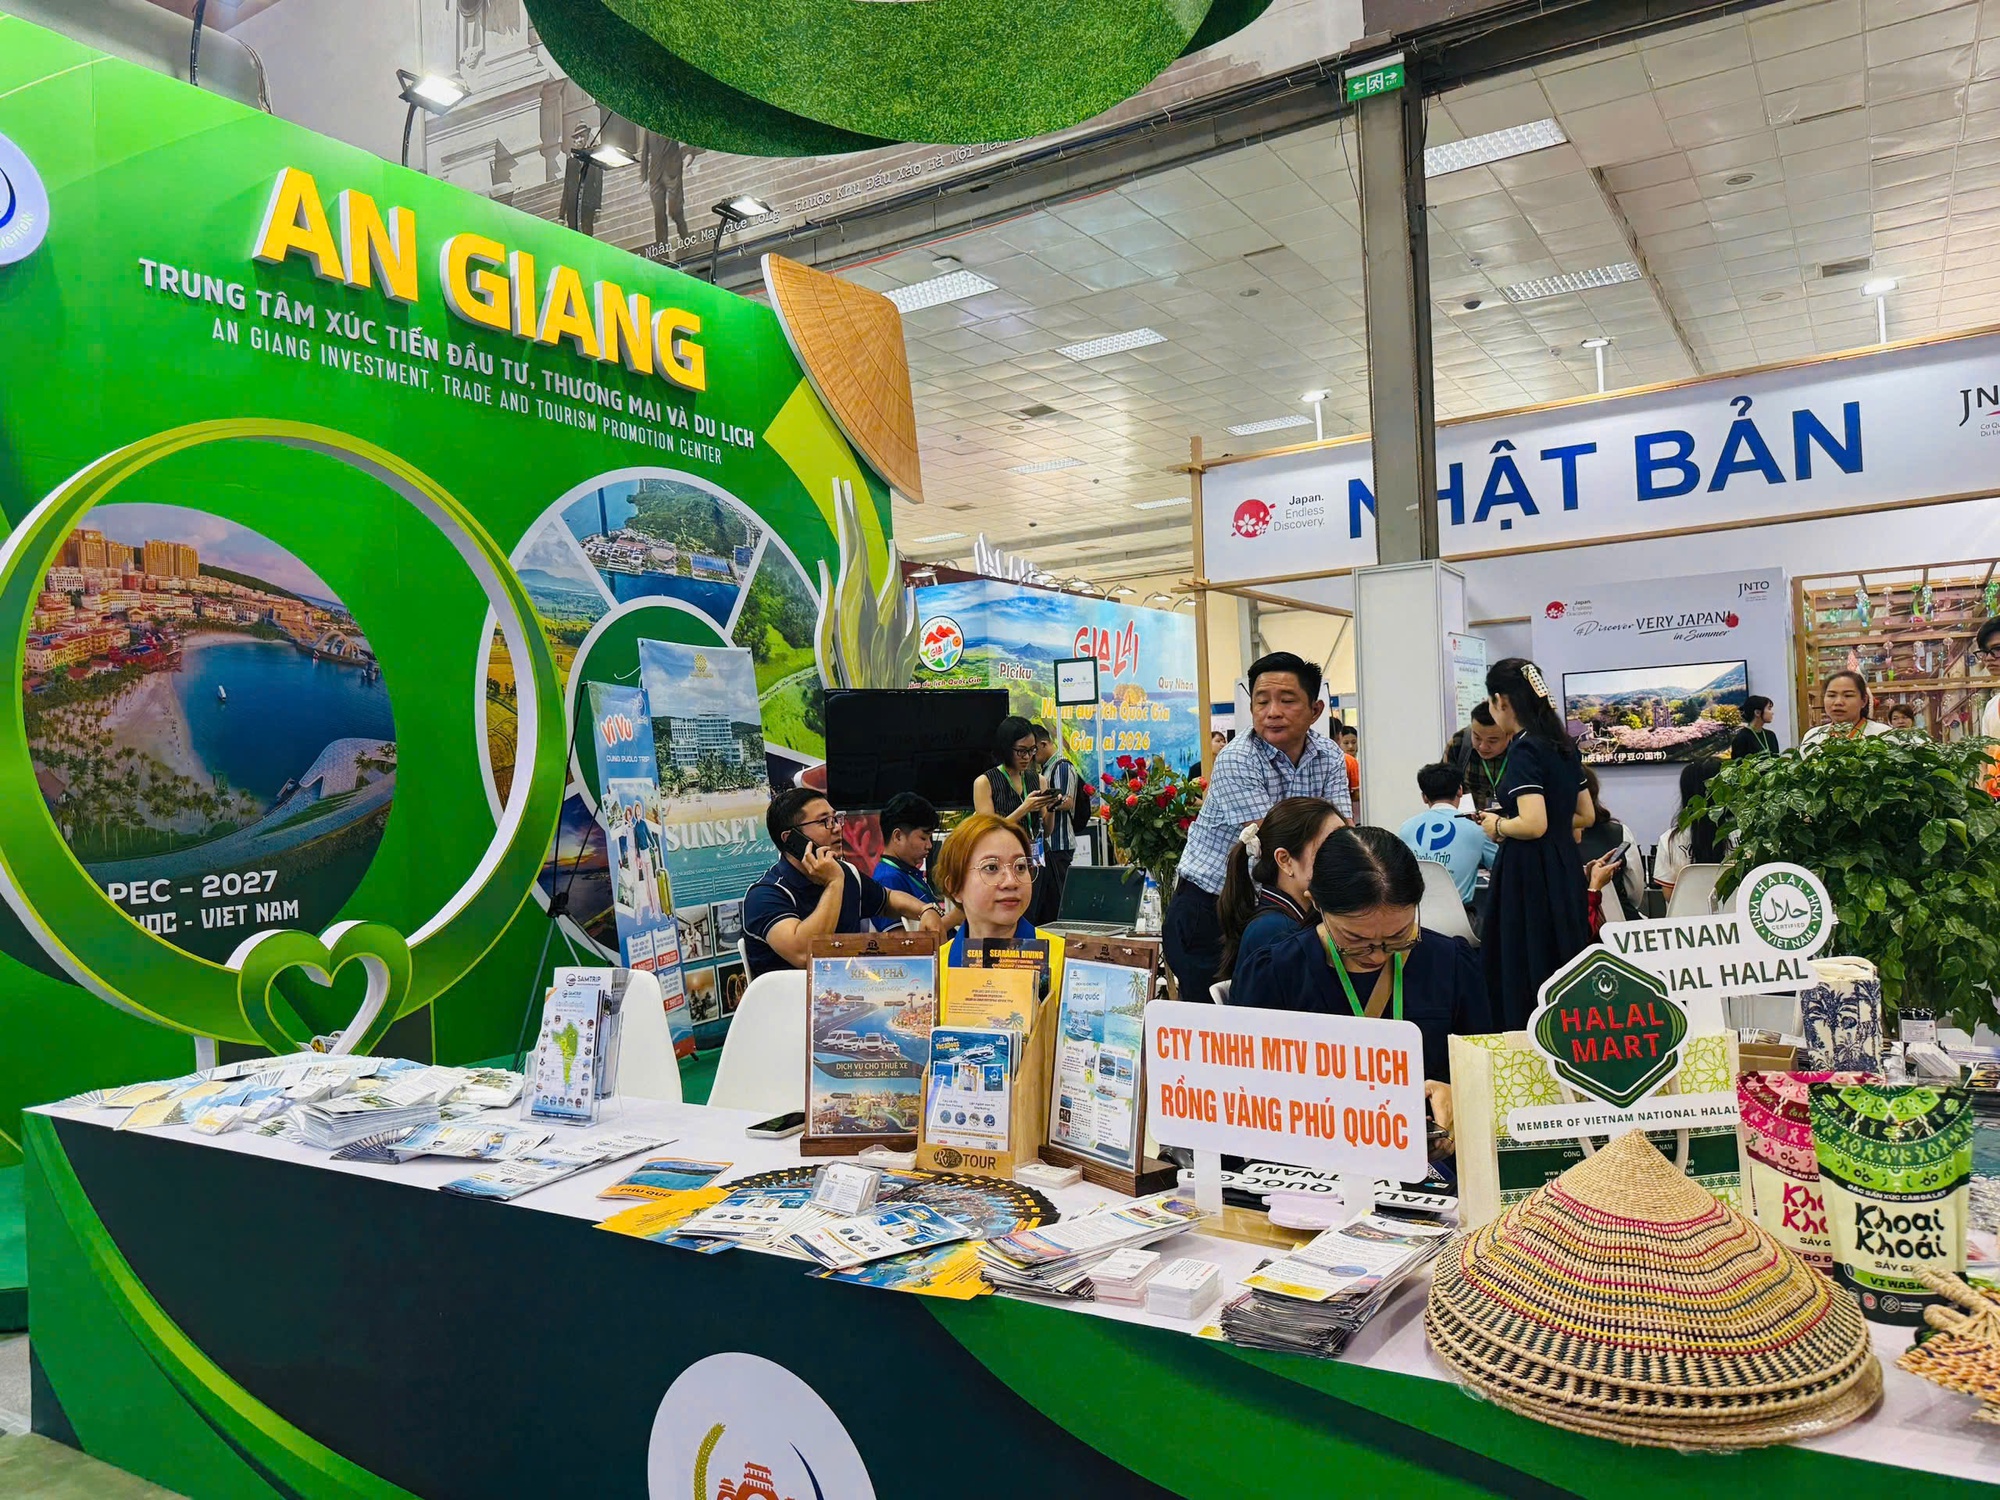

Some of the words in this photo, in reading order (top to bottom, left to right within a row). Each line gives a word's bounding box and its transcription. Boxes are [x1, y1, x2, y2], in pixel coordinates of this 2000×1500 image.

[795, 192, 831, 213] thuộc
[836, 183, 862, 201] Khu
[927, 153, 946, 173] Hà
[951, 145, 975, 166] Nội
[252, 166, 419, 304] AN
[440, 233, 706, 391] GIANG
[138, 257, 246, 311] TRUNG
[256, 289, 316, 330] TÂM
[325, 308, 378, 346] XÚC
[385, 324, 440, 362] TIẾN
[446, 340, 494, 376] ĐẦU
[501, 357, 537, 391] TƯ,
[541, 369, 623, 412] THƯƠNG
[628, 398, 662, 424] MẠI
[666, 404, 689, 431] VÀ
[694, 415, 716, 437] DU
[721, 422, 755, 449] LỊCH
[211, 316, 239, 345] AN
[250, 326, 311, 361] GIANG
[320, 343, 435, 394] INVESTMENT,
[441, 374, 493, 405] TRADE
[500, 390, 530, 415] AND
[536, 399, 597, 432] TOURISM
[602, 417, 675, 452] PROMOTION
[680, 438, 722, 465] CENTER
[1634, 395, 1864, 502] BẢN
[1289, 494, 1324, 506] Japan.
[1273, 517, 1325, 532] Discovery.
[1285, 506, 1325, 519] Endless
[1738, 580, 1770, 598] JNTO
[1573, 620, 1634, 637] #Discover
[1635, 615, 1674, 630] VERY
[1673, 631, 1683, 641] in
[1683, 629, 1731, 642] Summer
[999, 662, 1033, 681] Pleiku
[1119, 731, 1151, 752] 2026
[665, 815, 759, 852] SUNSET
[719, 838, 777, 858] Bliss
[1433, 851, 1451, 867] Trip
[108, 878, 172, 905] PEC
[202, 869, 278, 899] 2027
[1755, 873, 1805, 894] HALAL
[200, 904, 248, 930] VIET
[255, 899, 300, 924] NAM
[1764, 897, 1809, 923] حلال
[1612, 922, 1740, 955] VIETNAM
[1771, 922, 1806, 931] CERTIFIED
[1021, 949, 1044, 960] DIVING
[577, 975, 602, 983] SAMTRIP
[1719, 957, 1809, 987] HALAL
[1559, 1002, 1665, 1034] HALAL
[1156, 1026, 1193, 1062] CTY
[1198, 1030, 1255, 1069] TNHH
[1261, 1036, 1308, 1074] MTV
[1315, 1042, 1347, 1079] DU
[1354, 1046, 1409, 1091] LỊCH
[1570, 1032, 1661, 1064] MART
[836, 1062, 853, 1071] DỊCH
[864, 1062, 880, 1070] CHO
[899, 1062, 909, 1070] XE
[1160, 1074, 1217, 1124] RỒNG
[1222, 1086, 1282, 1132] VÀNG
[1288, 1096, 1335, 1140] PHÚ
[1343, 1099, 1408, 1150] QUỐC
[1516, 1118, 1563, 1132] MEMBER
[1566, 1116, 1581, 1128] OF
[1584, 1112, 1634, 1127] VIETNAM
[1637, 1106, 1697, 1123] NATIONAL
[1700, 1104, 1738, 1117] HALAL
[963, 1153, 996, 1170] TOUR
[1808, 1173, 1819, 1181] XÚ
[1855, 1202, 1945, 1234] Khoai
[1855, 1227, 1947, 1259] Khoái
[1889, 1279, 1926, 1290] WASA
